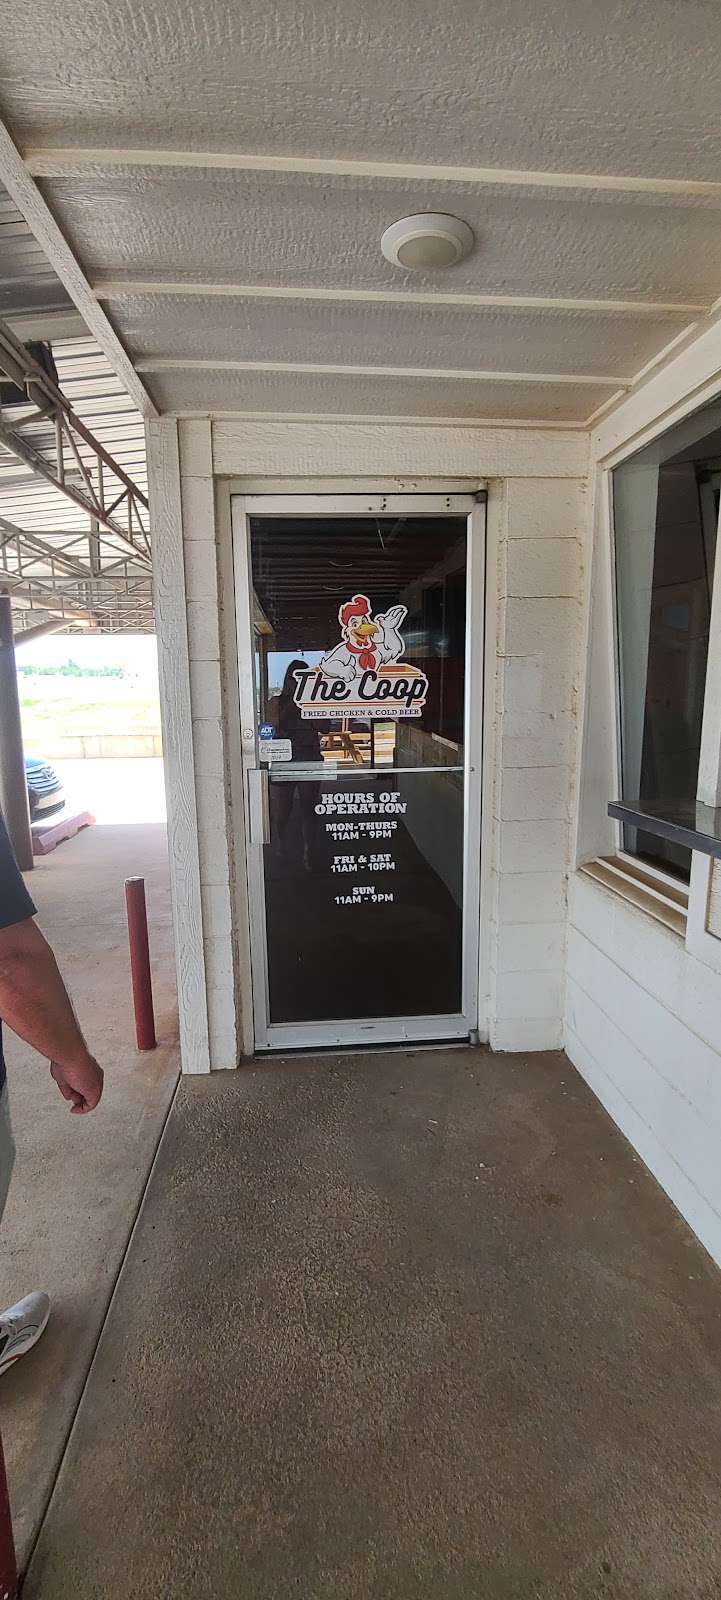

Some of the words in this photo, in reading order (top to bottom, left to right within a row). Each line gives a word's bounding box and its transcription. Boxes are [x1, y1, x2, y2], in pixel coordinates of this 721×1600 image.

[296, 672, 351, 701] The
[358, 670, 426, 708] Coop
[322, 793, 374, 804] HOURS
[380, 792, 400, 802] OF
[314, 803, 408, 814] OPERATION
[326, 821, 398, 832] MON-THURS
[332, 832, 360, 840] 11AM
[369, 830, 392, 838] 9PM
[334, 856, 354, 864] FRI
[370, 854, 392, 862] SAT
[330, 864, 358, 872] 11AM
[368, 862, 396, 870] 10PM
[352, 886, 375, 895] SUN
[334, 896, 362, 904] 11AM
[372, 894, 394, 902] 9PM
